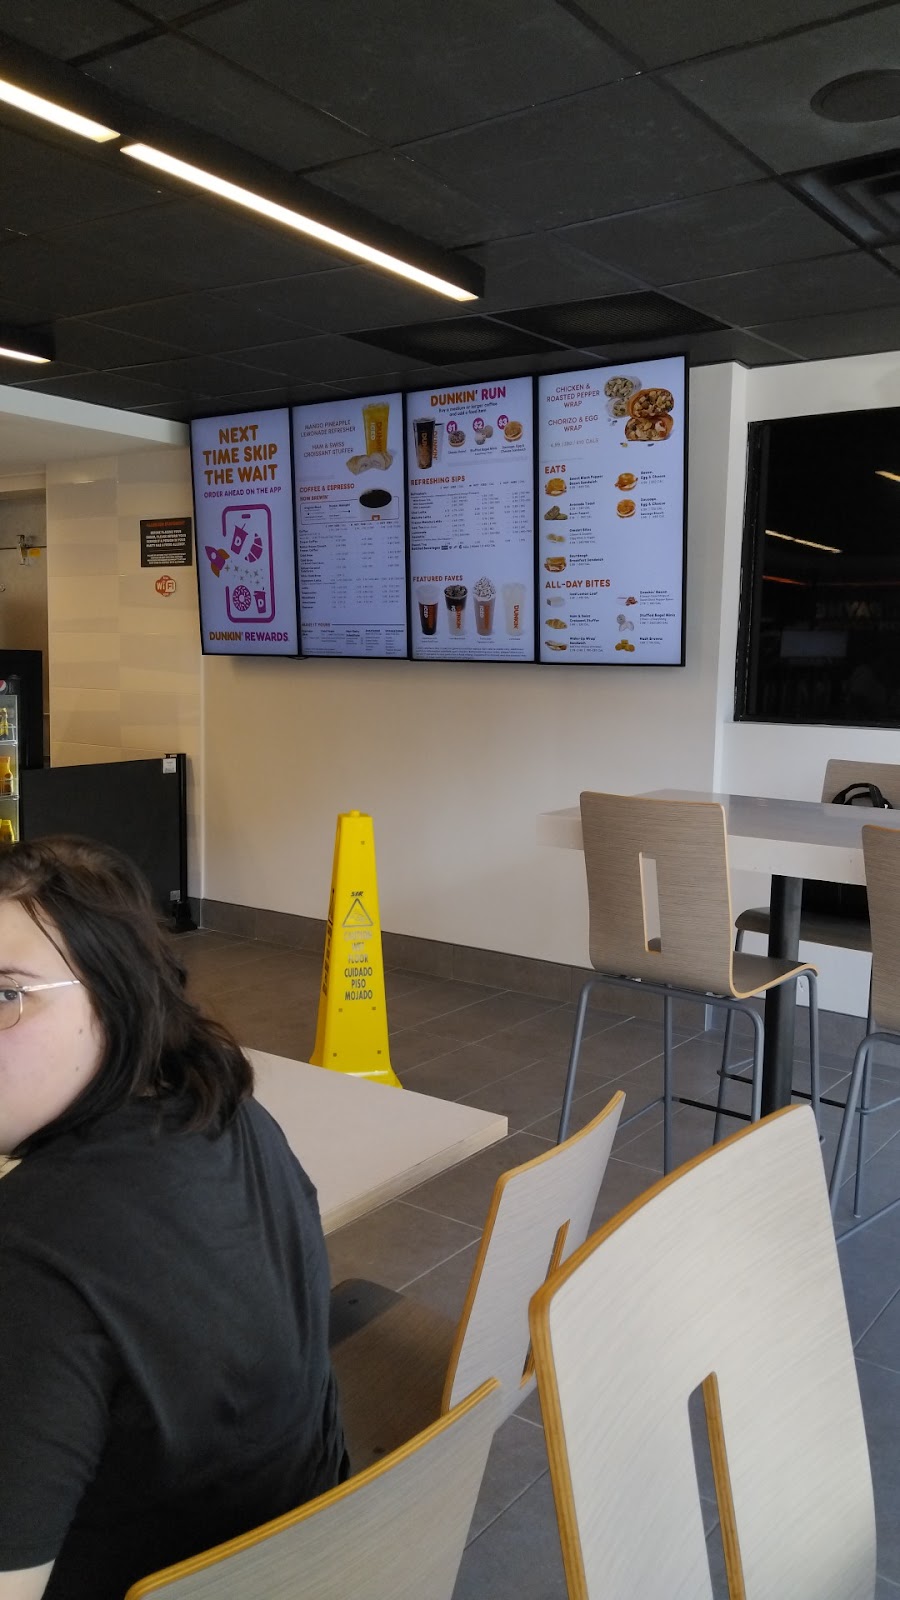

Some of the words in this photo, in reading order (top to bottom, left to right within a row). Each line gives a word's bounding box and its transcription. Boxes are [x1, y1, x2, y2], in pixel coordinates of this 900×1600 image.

[556, 384, 584, 394] CHICKEN
[430, 390, 478, 406] DUNKIN'
[481, 386, 506, 400] RUN
[546, 393, 575, 402] ROASTED
[577, 390, 600, 399] PEPPER
[305, 422, 324, 430] MANGO
[474, 421, 483, 429] $2
[548, 418, 578, 426] CHORIZO
[448, 424, 456, 432] $1
[219, 425, 258, 444] NEXT
[203, 448, 240, 466] TIME
[244, 444, 278, 462] SKIP
[544, 465, 566, 474] EATS
[204, 468, 234, 485] THE
[238, 464, 278, 483] WAIT
[410, 477, 450, 486] REFRESHING
[546, 580, 583, 588] ALL-DAY
[586, 579, 610, 587] BITES
[209, 632, 243, 641] DUNKIN'
[245, 632, 288, 641] REWARDS
[348, 954, 368, 963] FLOOR
[344, 967, 372, 977] CUIDADO
[352, 979, 366, 988] PISO
[345, 990, 373, 1000] MOJADO
